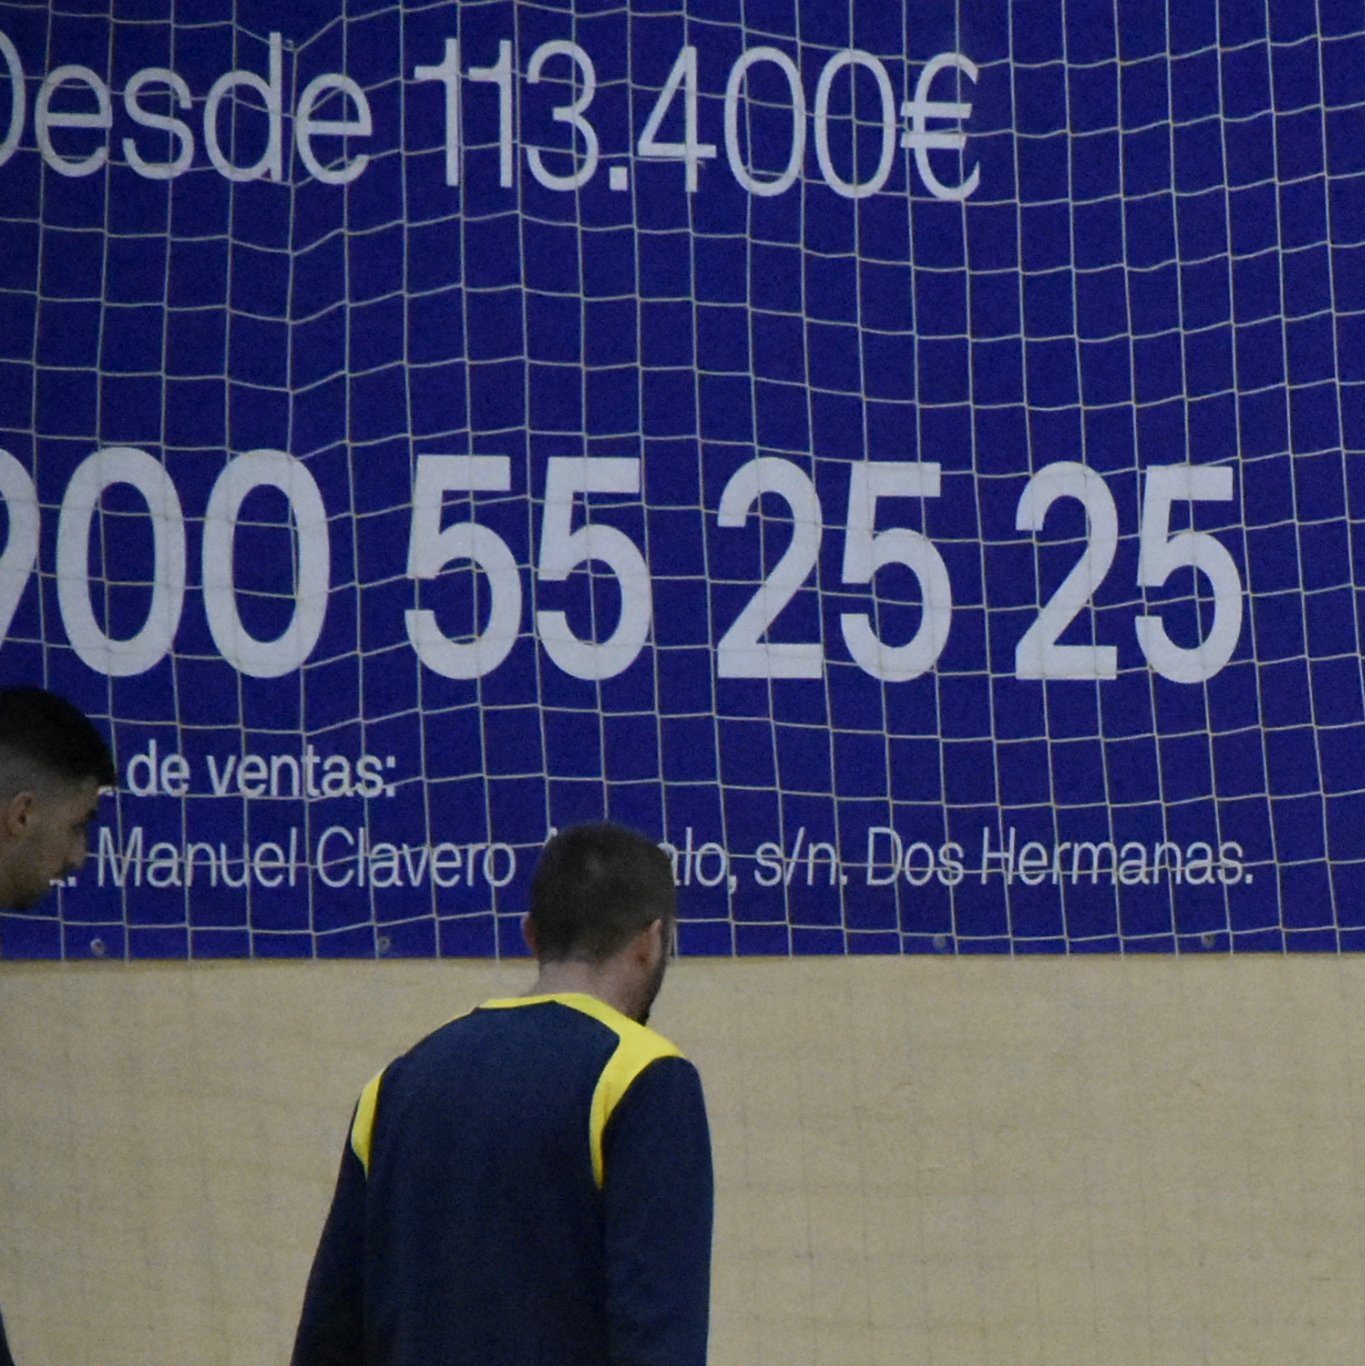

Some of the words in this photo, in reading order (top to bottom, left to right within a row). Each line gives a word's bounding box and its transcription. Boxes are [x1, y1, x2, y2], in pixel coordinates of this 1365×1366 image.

[414, 38, 982, 200] 113.400€
[404, 454, 652, 681] 55
[717, 457, 953, 682] 25
[1014, 460, 1243, 683] 25
[126, 739, 190, 797] de
[207, 744, 396, 798] ventas:
[97, 826, 298, 888] Manuel
[316, 826, 516, 888] Clavero
[753, 826, 848, 886] s/n.
[866, 827, 965, 887] Dos
[981, 826, 1254, 887] Hermanas.
